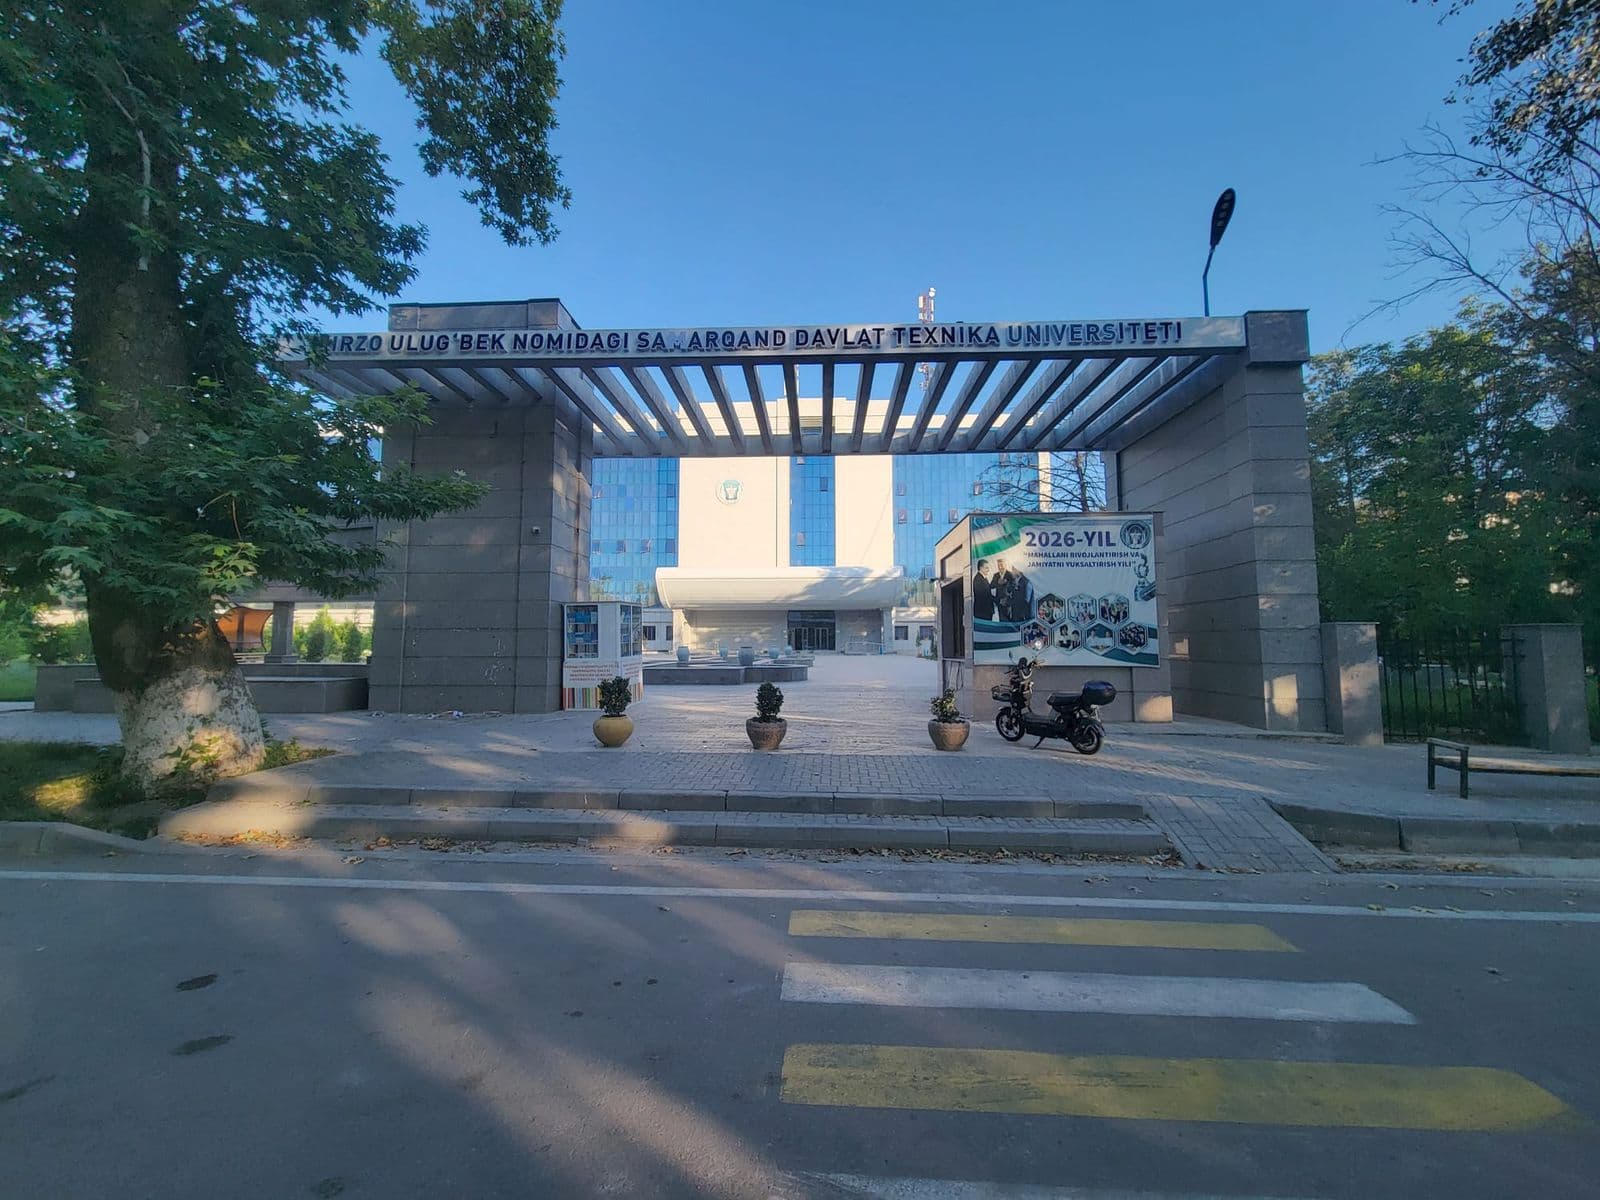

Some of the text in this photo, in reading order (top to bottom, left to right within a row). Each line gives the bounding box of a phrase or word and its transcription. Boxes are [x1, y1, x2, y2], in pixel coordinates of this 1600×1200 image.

[318, 335, 383, 351] IRZO
[513, 332, 629, 349] NOMIDAGI
[795, 328, 885, 346] DAVLAT
[893, 326, 1000, 344] TEXNIKA
[1008, 322, 1182, 344] UNIVERSITETI
[1025, 531, 1116, 547] 2026-YIL
